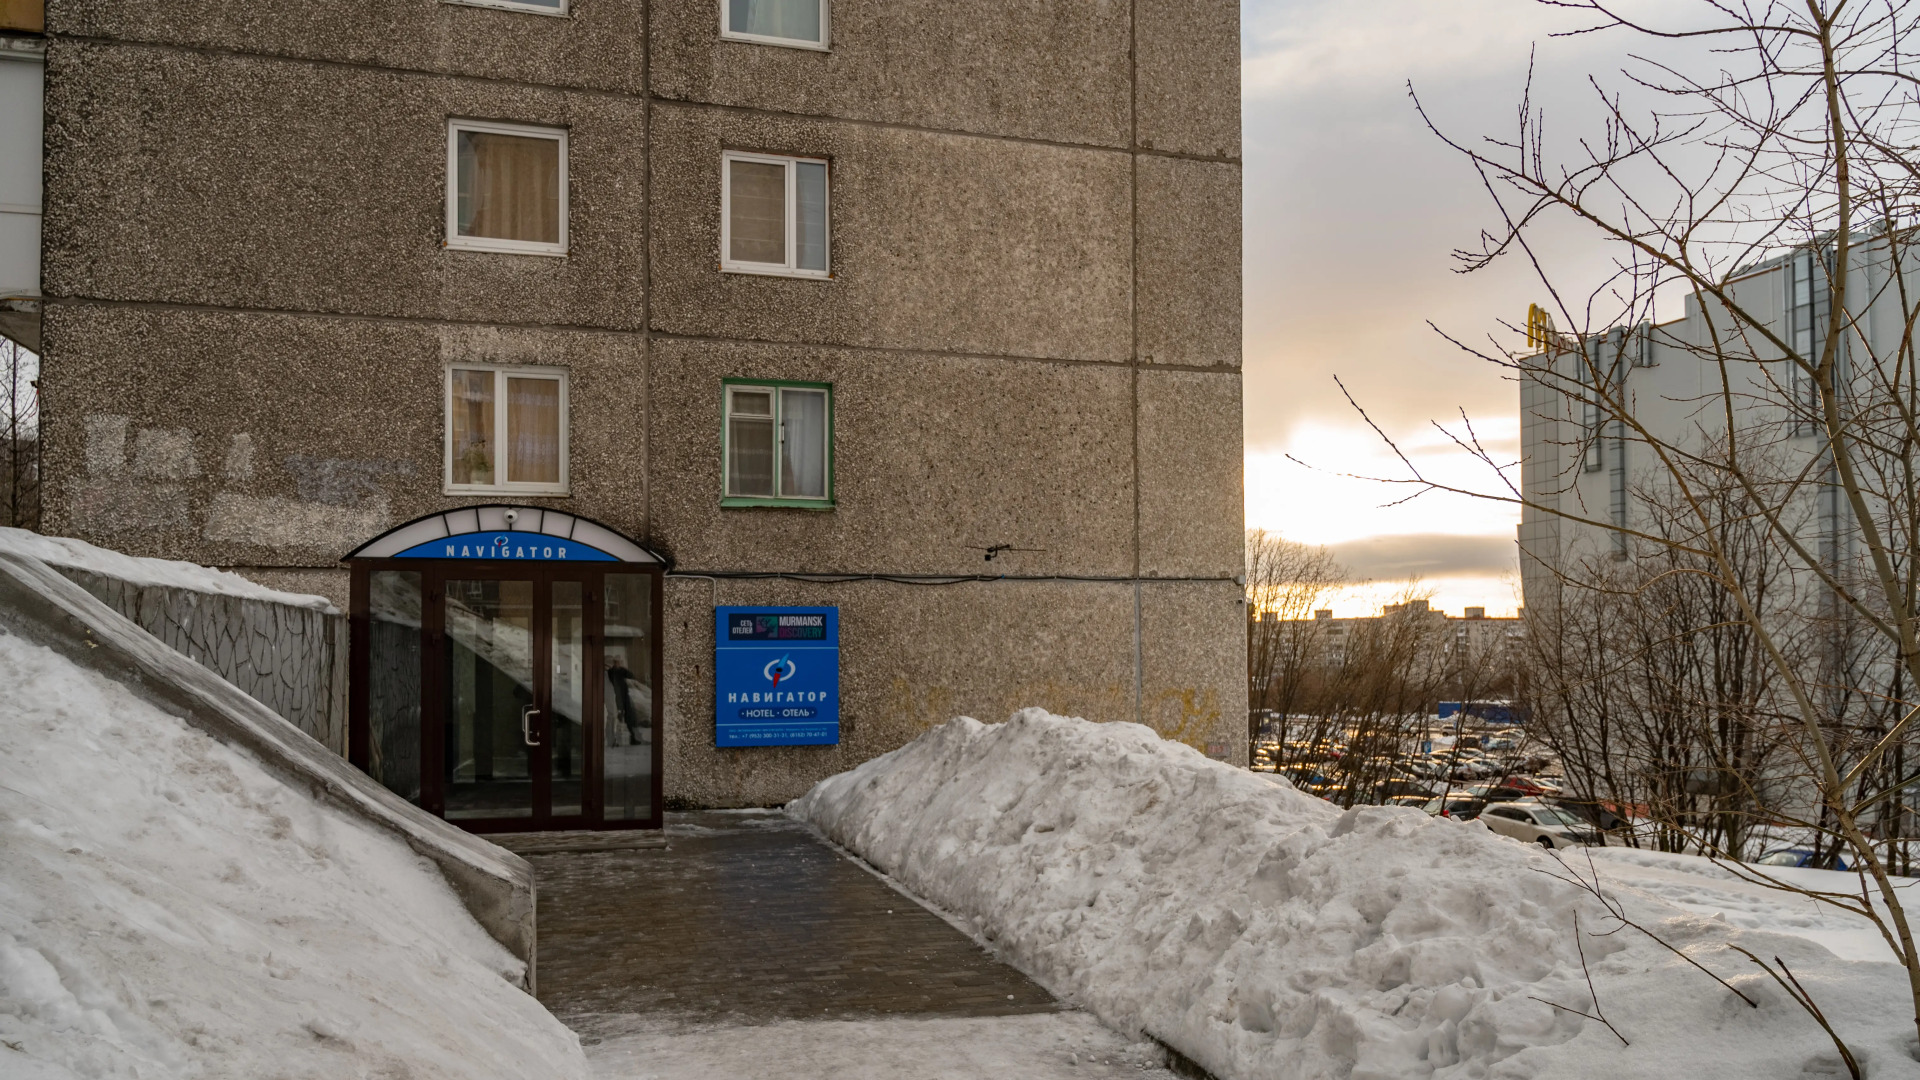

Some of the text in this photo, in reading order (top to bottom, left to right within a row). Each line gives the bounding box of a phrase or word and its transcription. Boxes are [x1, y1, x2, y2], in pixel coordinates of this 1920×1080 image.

[446, 545, 567, 558] NAVIGATOR
[779, 616, 823, 627] MURMANSK
[732, 626, 753, 635] ОТЕЛЕЙ
[779, 627, 823, 638] DISCOVERY
[728, 692, 827, 703] НАВИГАТОР
[746, 708, 810, 718] HOTEL ОТЕЛЬ
